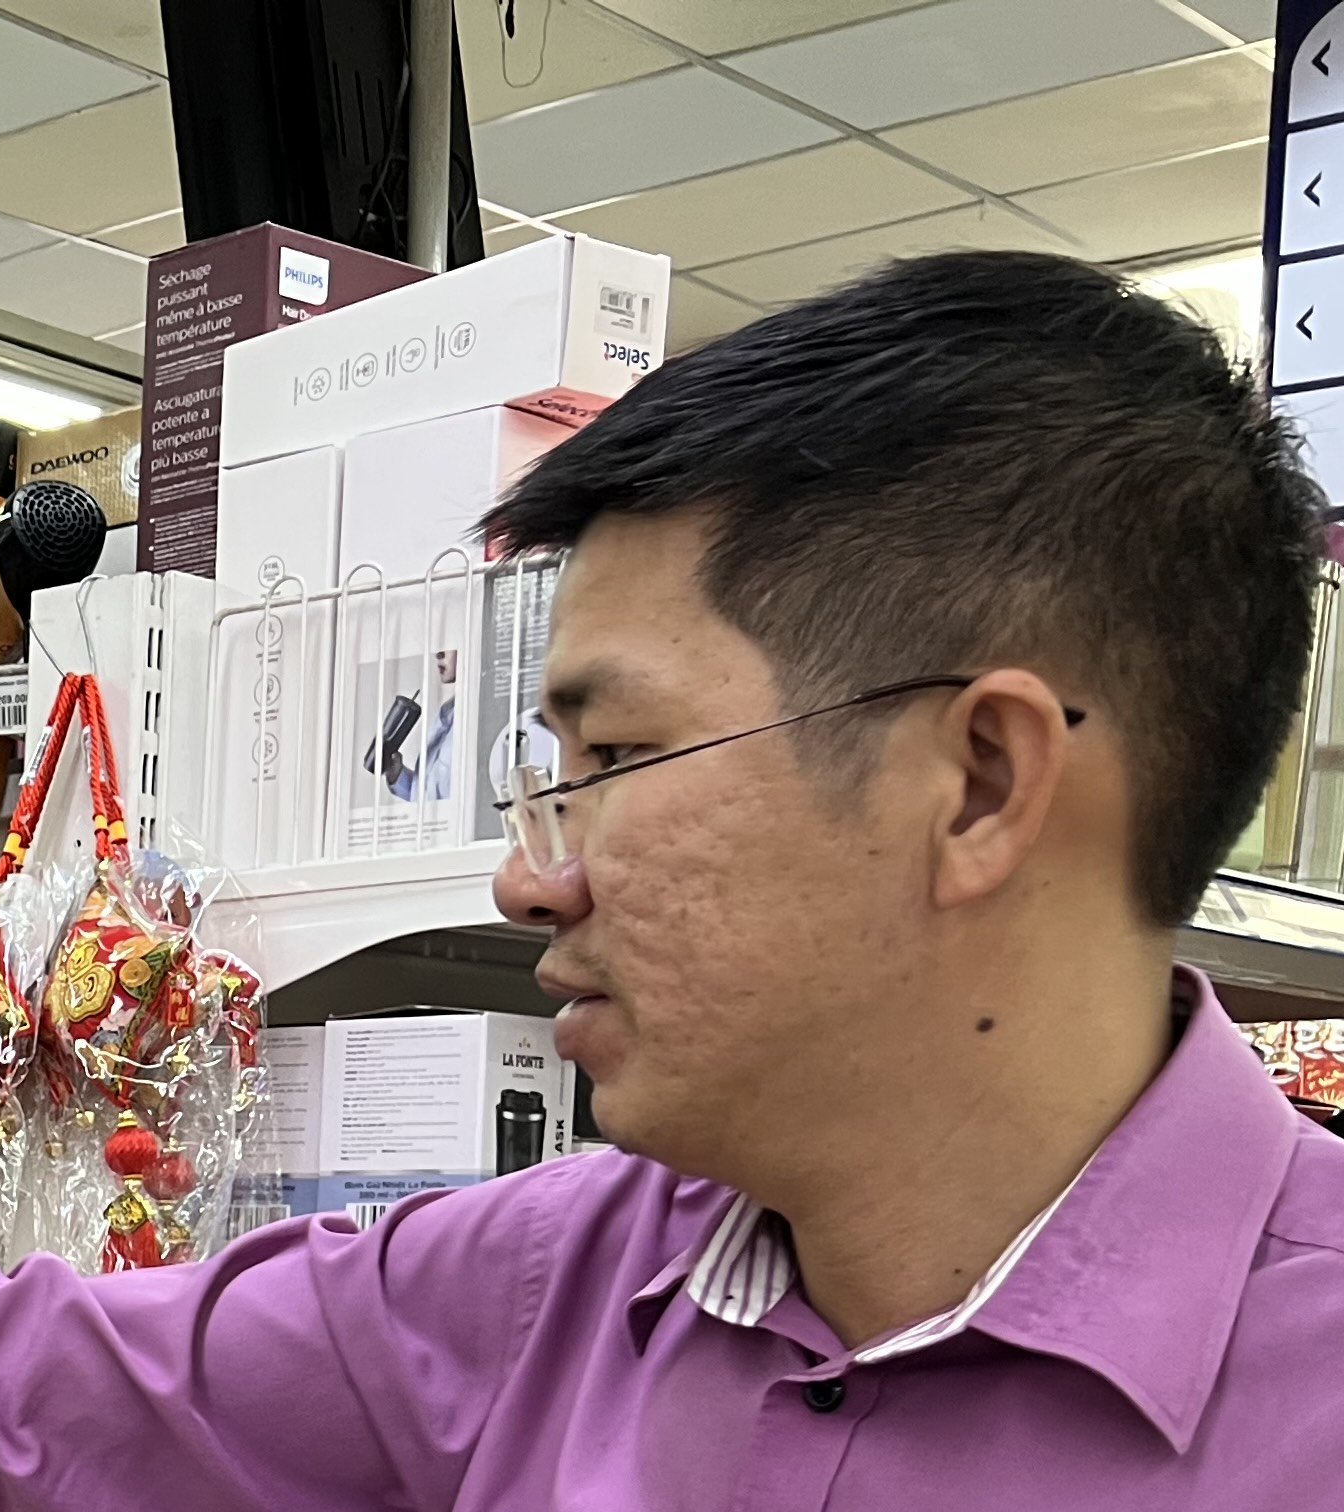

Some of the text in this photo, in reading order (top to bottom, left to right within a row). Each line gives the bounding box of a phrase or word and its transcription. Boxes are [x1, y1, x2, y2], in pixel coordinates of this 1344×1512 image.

[285, 267, 323, 288] PHILIPS
[157, 283, 208, 311] puissant
[207, 294, 242, 314] basse
[604, 342, 650, 370] Select
[152, 410, 199, 434] potente
[31, 446, 109, 475] DAEWOO
[172, 447, 208, 465] basse
[502, 1053, 544, 1069] LA FONTE
